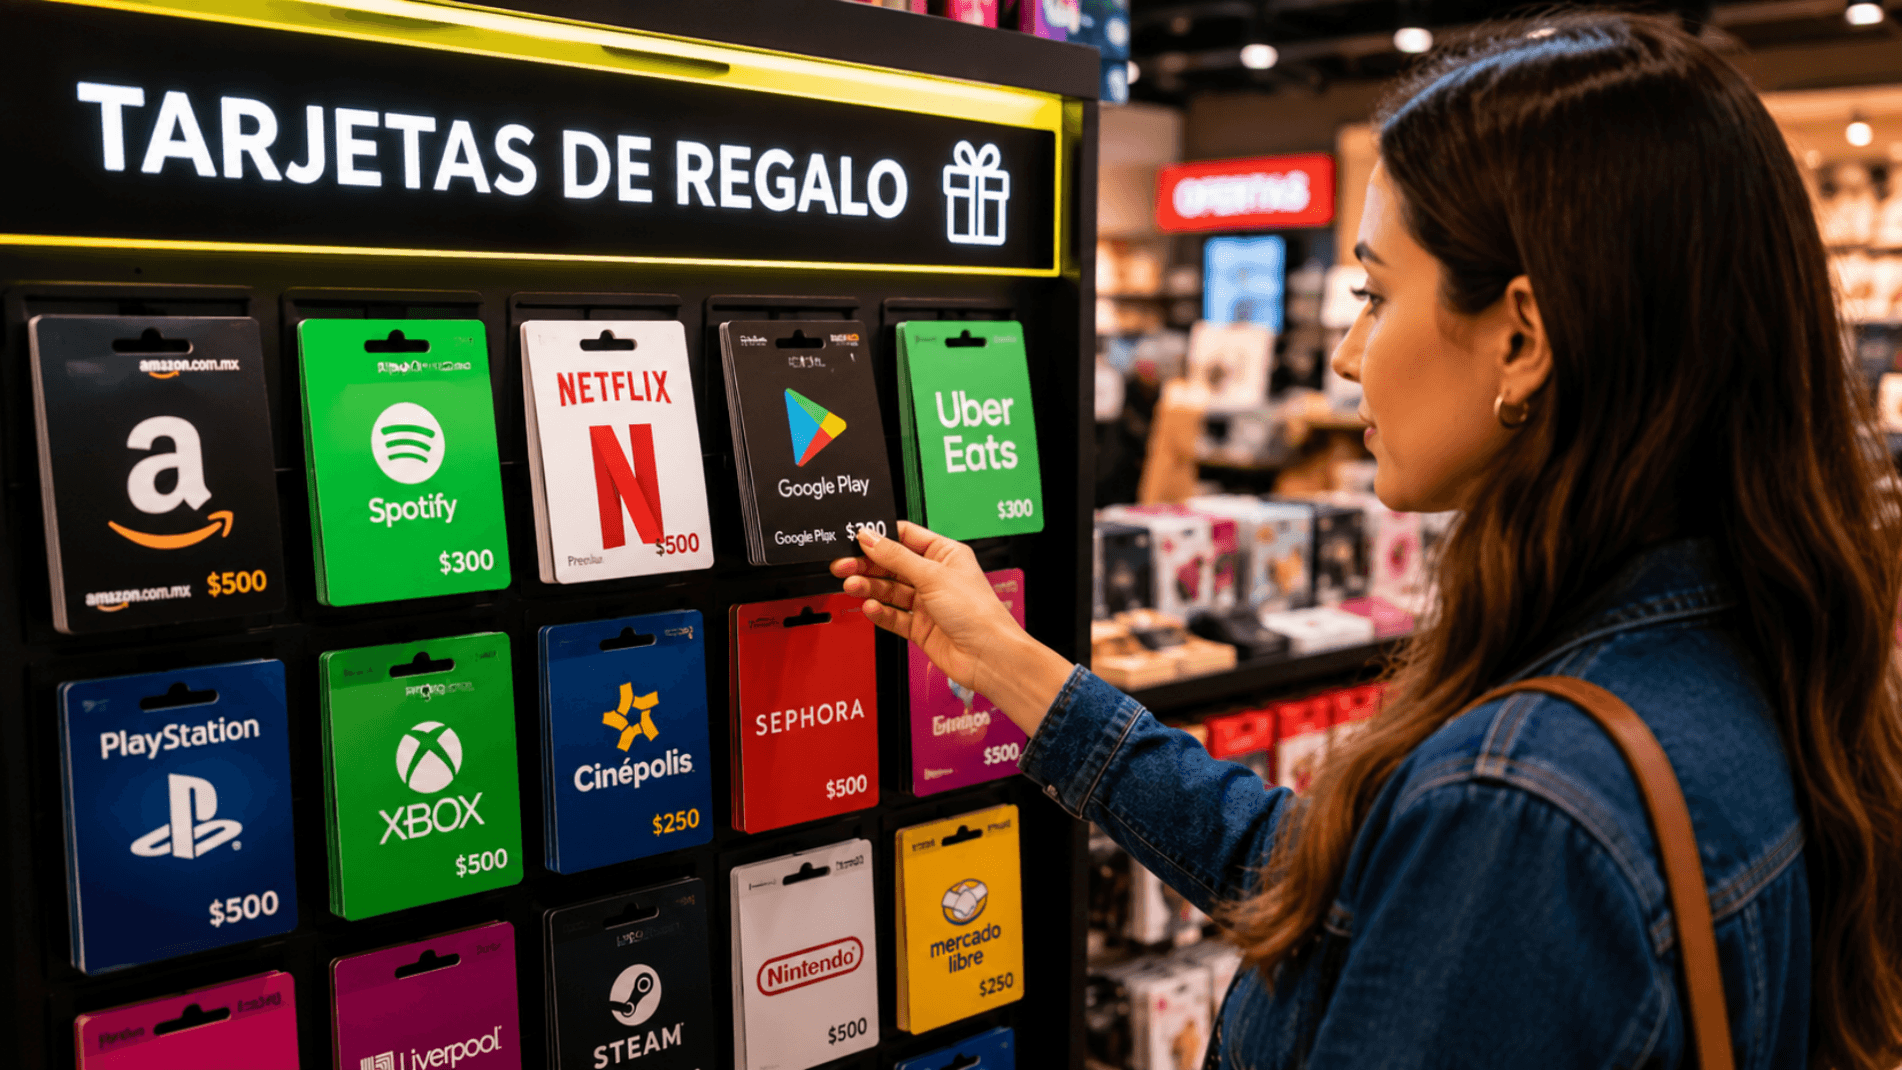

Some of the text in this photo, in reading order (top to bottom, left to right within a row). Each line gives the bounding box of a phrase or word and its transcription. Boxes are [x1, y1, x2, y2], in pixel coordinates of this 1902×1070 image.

[77, 82, 908, 219] TARJETAS DE REGALO
[139, 359, 240, 372] amazon.com.mx
[556, 370, 672, 407] NETFLIX
[935, 390, 1013, 429] Uber
[126, 415, 213, 515] a
[943, 434, 1018, 473] Eats
[588, 423, 665, 550] N
[778, 474, 869, 500] Google Play
[368, 492, 457, 528] Spotify
[997, 498, 1033, 519] $300
[655, 532, 700, 557] $500
[774, 529, 814, 547] Google
[439, 548, 494, 576] $300
[85, 584, 192, 607] amazon.com.mx
[206, 569, 267, 598] $500
[755, 698, 865, 736] SEPHORA
[100, 716, 260, 760] PlayStation
[983, 742, 1020, 767] $500
[574, 748, 693, 793] Cinépolis
[825, 773, 868, 800] $500
[378, 791, 486, 846] XBOX
[652, 807, 700, 837] $250
[455, 848, 508, 879] $500
[209, 890, 279, 928] $500
[930, 922, 1002, 958] mercado
[766, 948, 854, 988] Nintendo
[948, 950, 984, 974] libre
[979, 972, 1014, 998] $250
[399, 1025, 501, 1070] Liverpool
[593, 1022, 682, 1070] STEAM
[828, 1017, 868, 1046] $500
